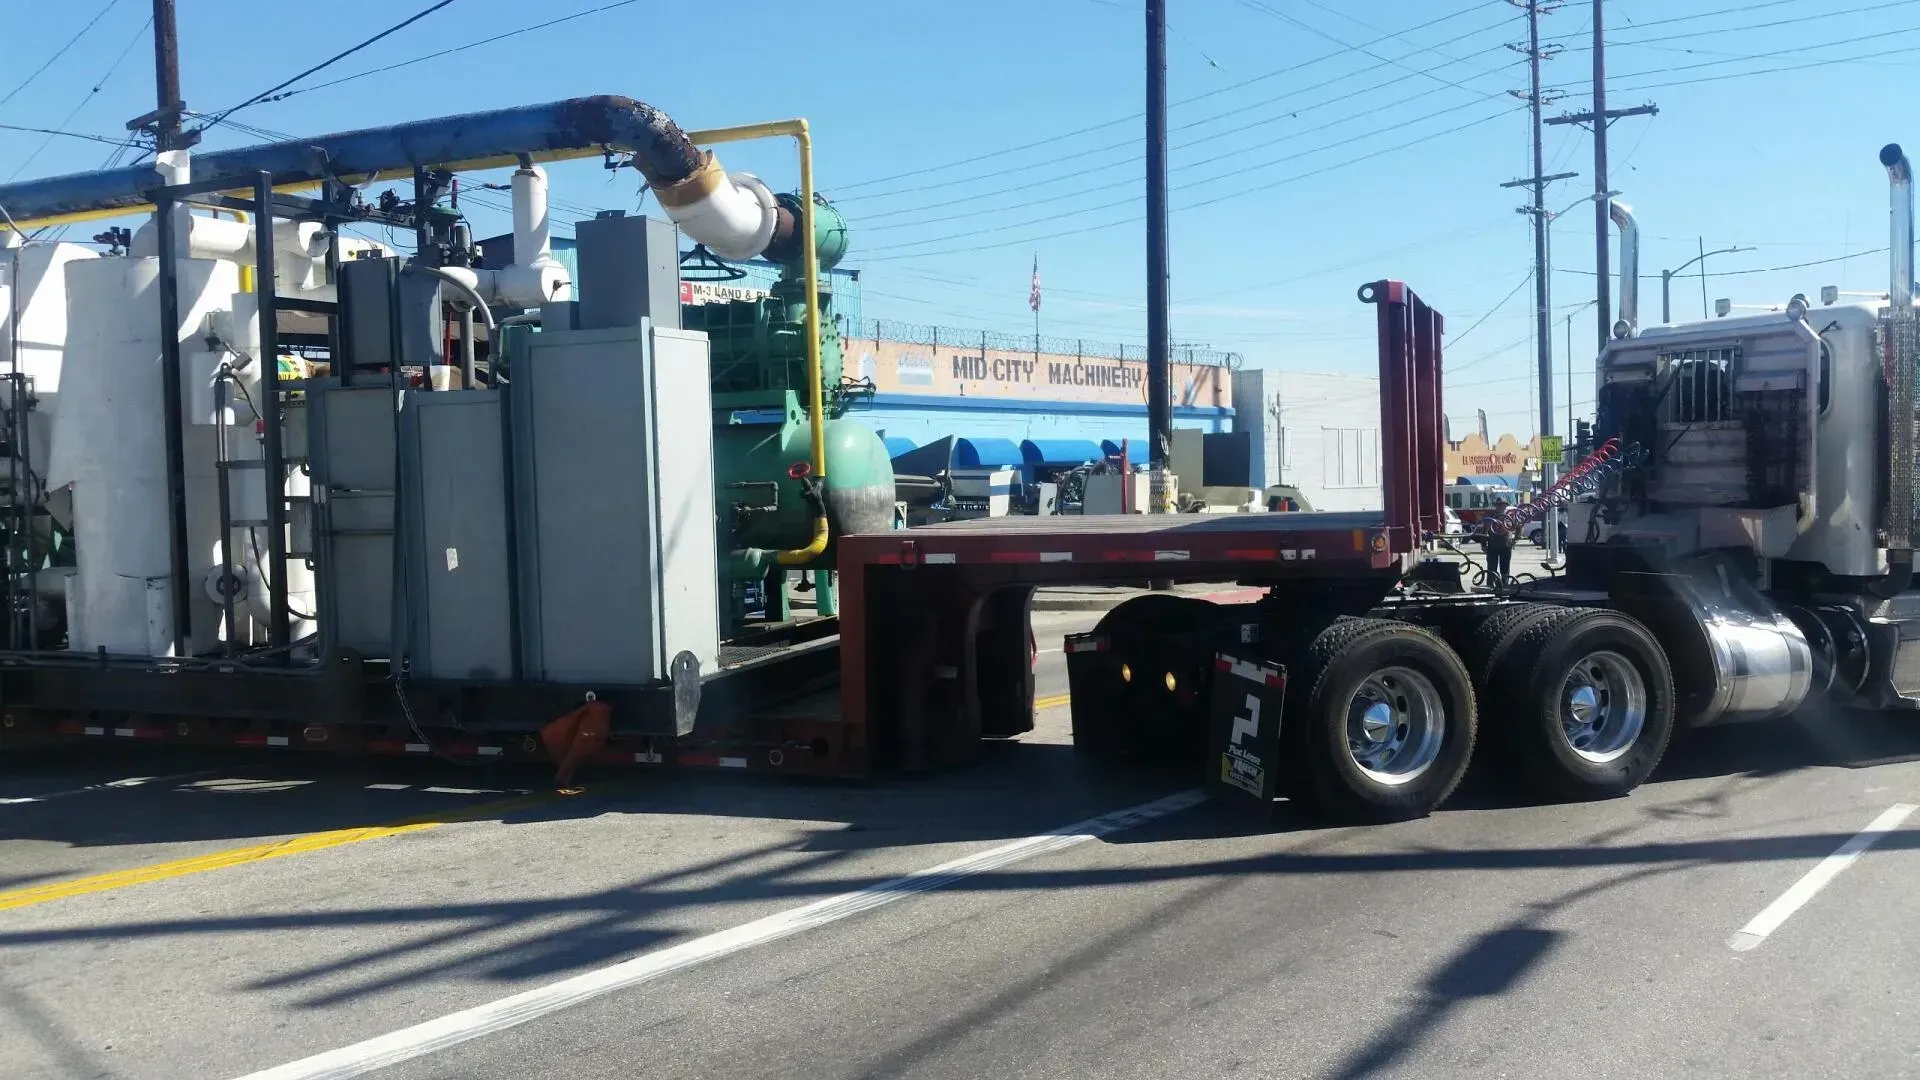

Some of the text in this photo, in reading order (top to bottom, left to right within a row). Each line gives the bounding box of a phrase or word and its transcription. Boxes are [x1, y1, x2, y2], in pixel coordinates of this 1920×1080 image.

[693, 284, 711, 297] M-3
[714, 287, 742, 299] LAND
[745, 290, 752, 300] &
[953, 355, 988, 380] MID
[992, 358, 1034, 383] CITY
[1048, 362, 1142, 389] MACHINERY
